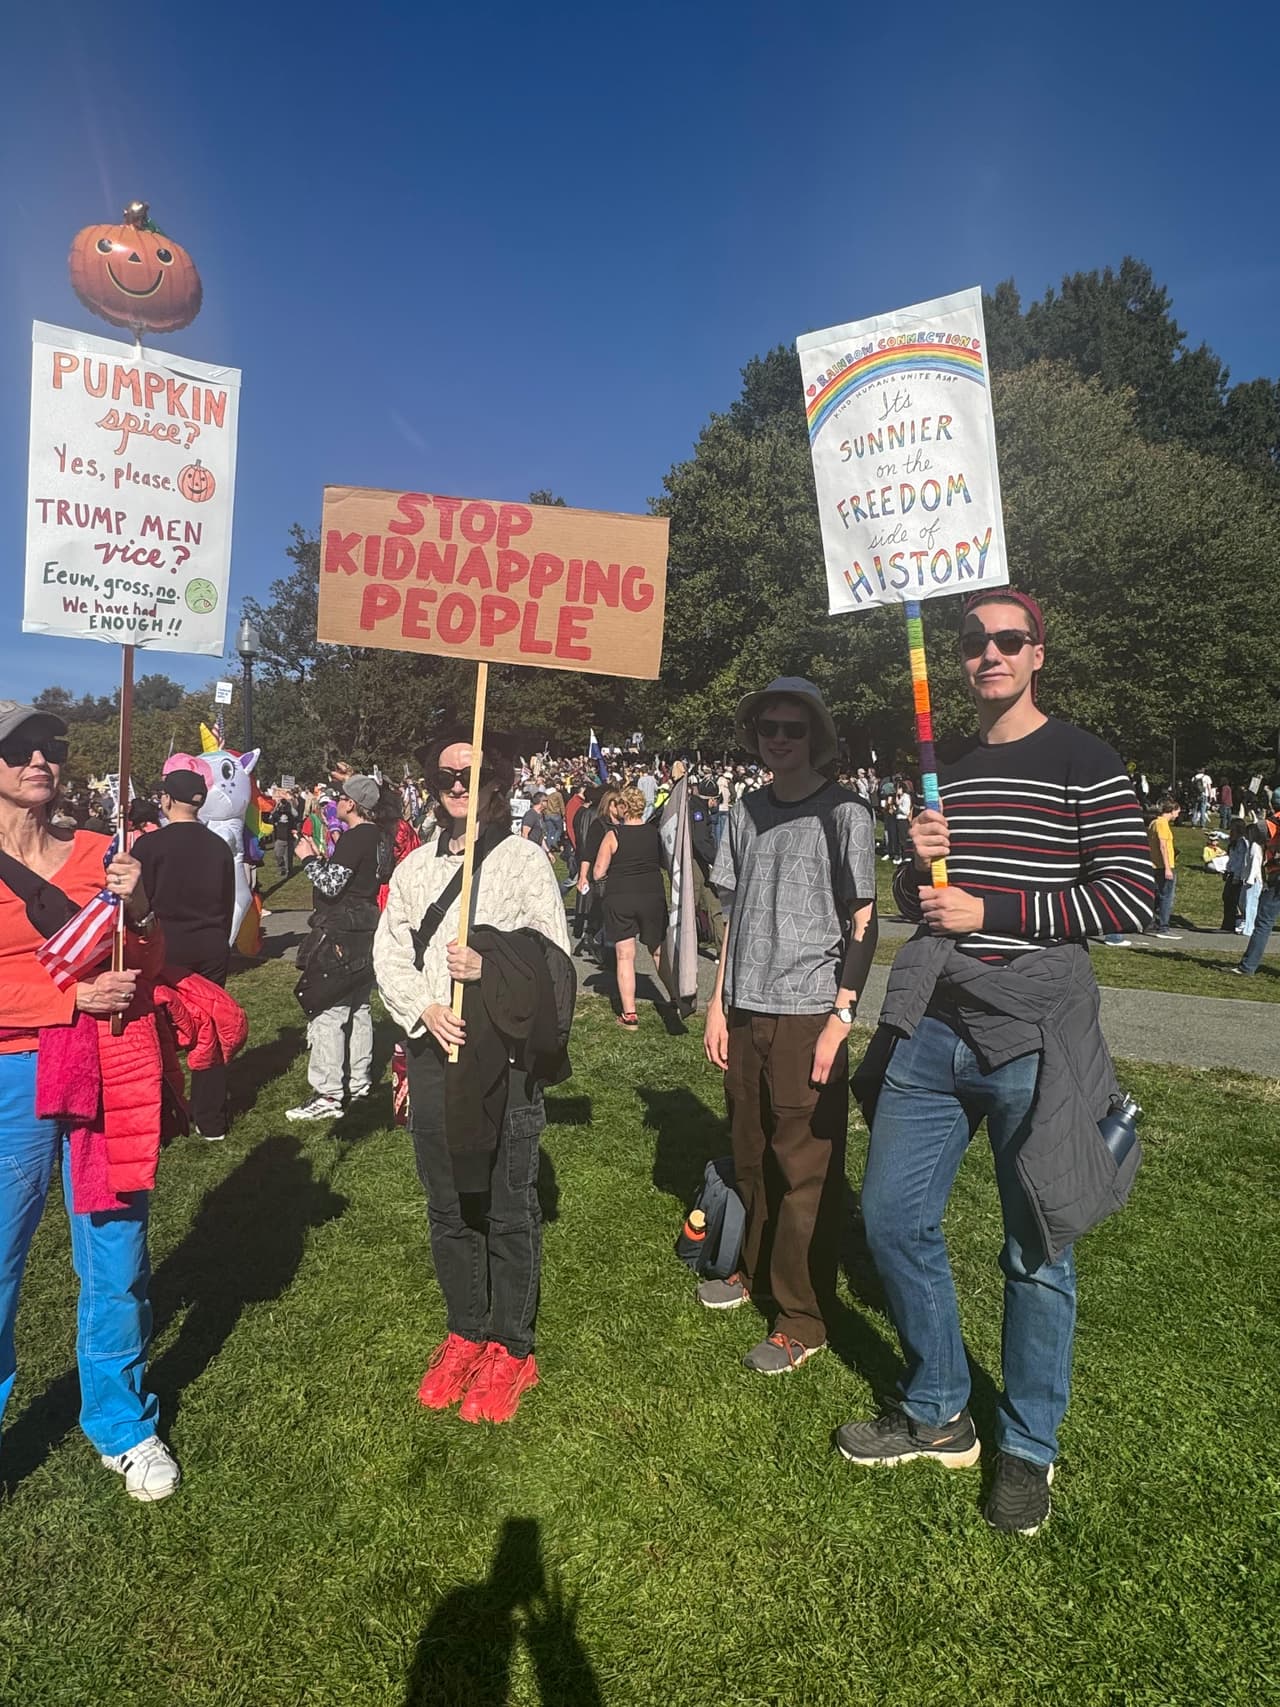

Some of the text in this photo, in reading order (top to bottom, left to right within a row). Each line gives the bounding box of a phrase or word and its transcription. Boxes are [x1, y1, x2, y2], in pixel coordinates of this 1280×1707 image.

[816, 332, 971, 387] RAINBOW CONNECTION
[53, 352, 226, 428] PUMPKIN
[833, 399, 852, 419] KIND
[855, 377, 896, 399] HUMANS
[900, 372, 931, 381] UNITE
[878, 387, 913, 421] It's
[95, 408, 200, 455] spice?
[840, 415, 952, 463] SUNNIER
[54, 443, 176, 492] Yes, please.
[876, 448, 934, 479] on the
[35, 498, 202, 545] TRUMP MEN
[388, 493, 533, 549] STOP
[837, 473, 972, 530] FREEDOM
[94, 539, 191, 574] vice?
[867, 518, 941, 550] side of
[43, 561, 180, 602] Eeuw, gross, no.
[325, 530, 655, 613] KIDNAPPING
[843, 527, 992, 603] HISTORY
[62, 597, 157, 617] We have had
[359, 583, 594, 661] PEOPLE
